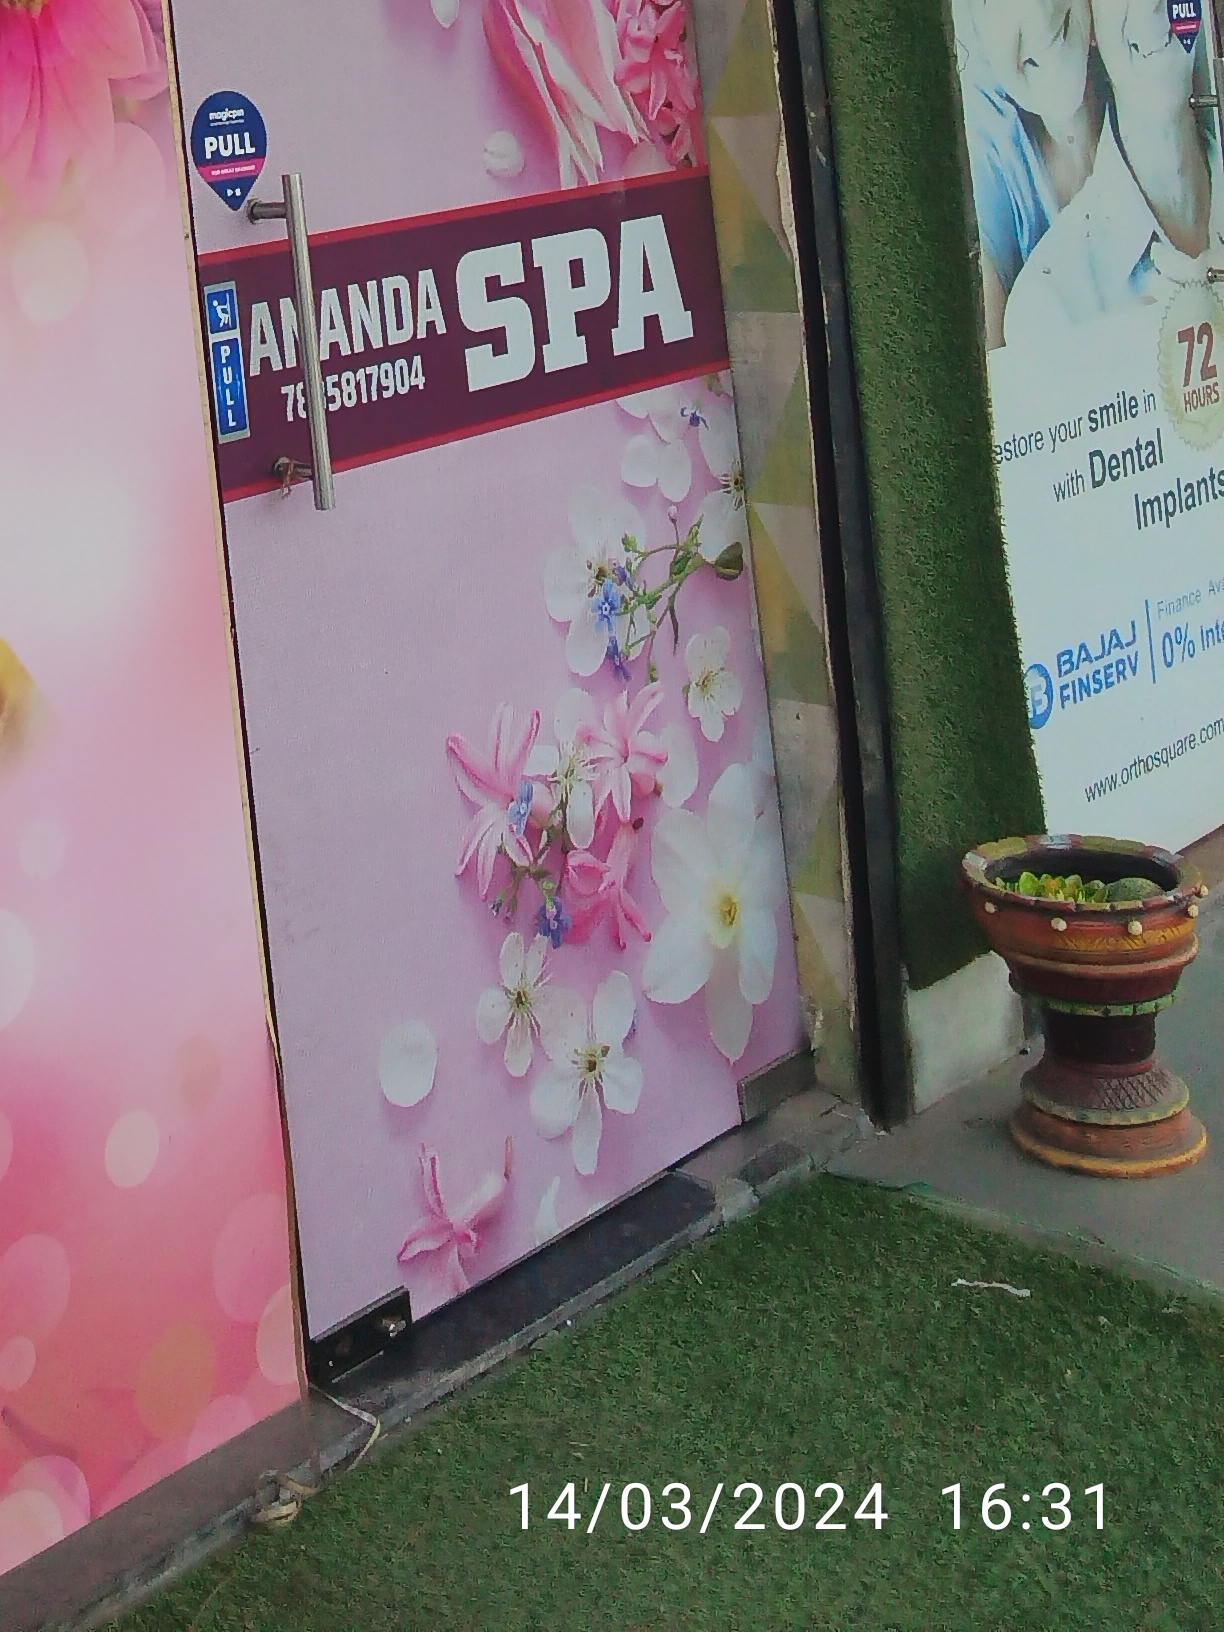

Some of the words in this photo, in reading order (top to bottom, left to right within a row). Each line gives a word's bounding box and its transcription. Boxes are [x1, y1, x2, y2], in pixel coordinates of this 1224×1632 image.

[1172, 2, 1196, 19] PULL
[204, 132, 255, 159] PULL
[455, 214, 694, 392] SPA
[1177, 322, 1218, 387] 72
[220, 345, 238, 429] PULL
[280, 355, 426, 423] 785817904
[1183, 381, 1221, 413] HOURS
[993, 429, 1045, 465] estore
[1048, 416, 1083, 454] your
[1087, 390, 1139, 433] smile
[1142, 389, 1156, 413] in
[1053, 469, 1085, 502] with
[1089, 427, 1164, 489] Dental
[1134, 467, 1224, 531] Implants
[1156, 588, 1202, 619] Finance
[1056, 620, 1137, 678] BAJAJ
[1161, 622, 1196, 668] 0%
[1059, 650, 1139, 709] FINSERV
[1084, 718, 1224, 803] www.orthosquare.com
